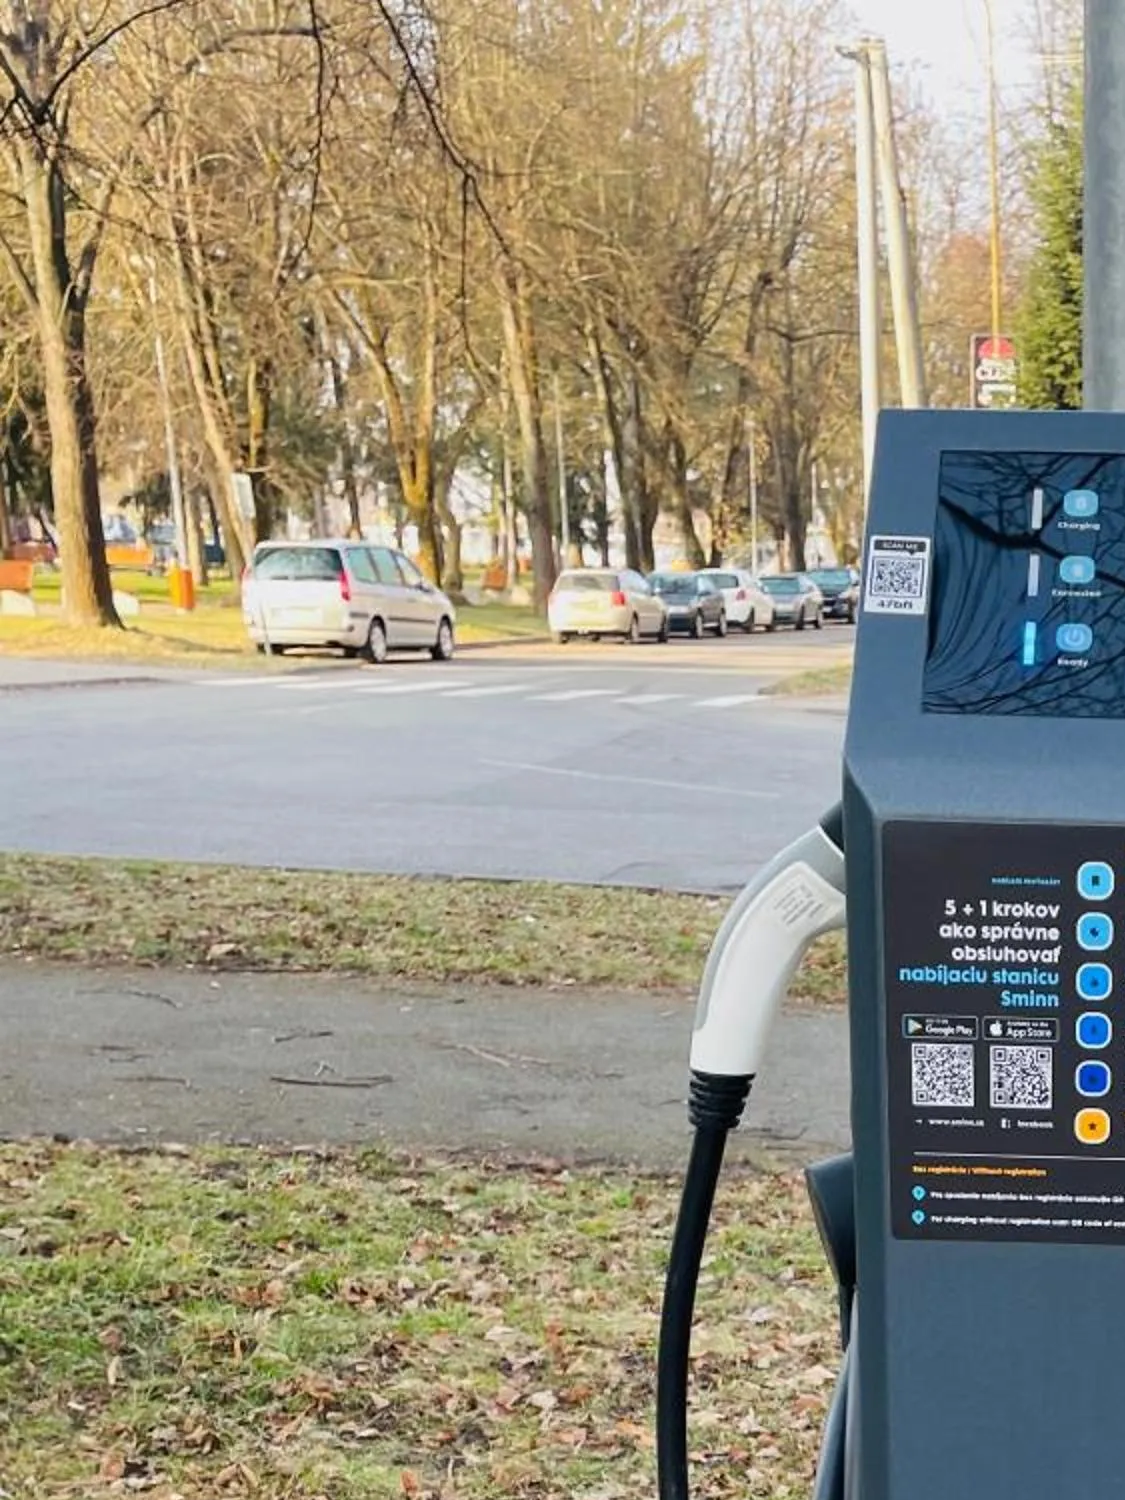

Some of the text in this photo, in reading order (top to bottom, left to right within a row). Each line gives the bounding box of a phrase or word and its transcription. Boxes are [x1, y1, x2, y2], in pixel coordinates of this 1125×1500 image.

[944, 899, 1061, 918] 5 + 1 krokov
[939, 921, 1061, 942] ako správne
[951, 945, 1062, 963] obsluhovať
[899, 964, 1059, 985] nabíjaciu stanicu
[1001, 989, 1059, 1007] Sminn
[1006, 1027, 1027, 1039] App
